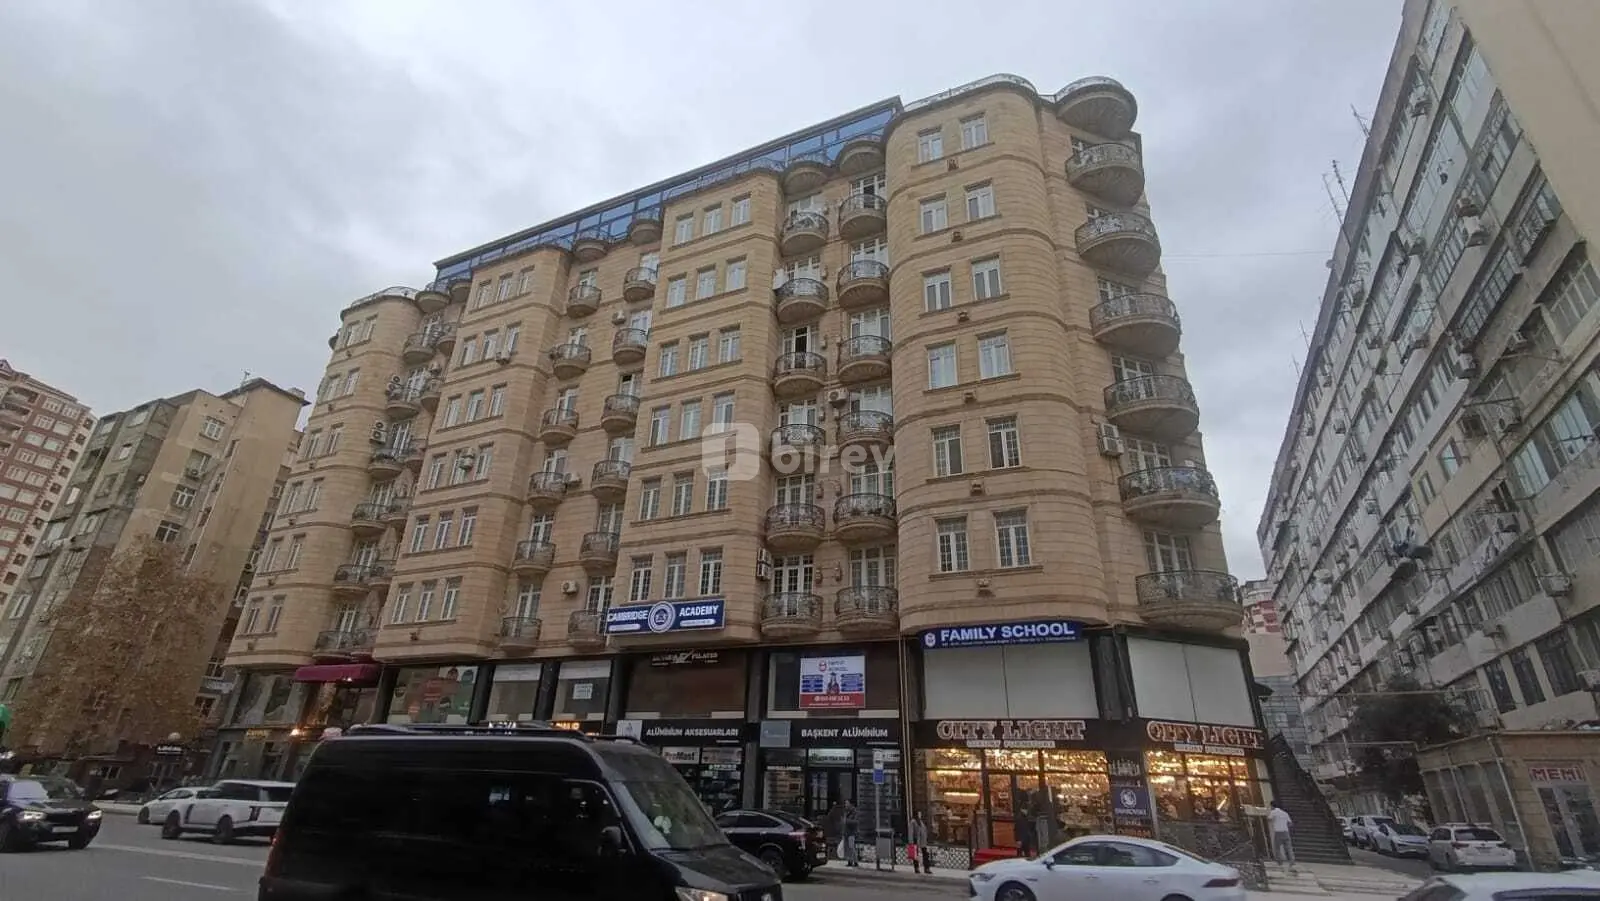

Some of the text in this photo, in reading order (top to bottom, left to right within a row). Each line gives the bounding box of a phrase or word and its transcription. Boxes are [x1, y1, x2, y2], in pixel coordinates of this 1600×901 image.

[607, 605, 719, 622] CAMBRIDGE ACADEMY
[940, 627, 997, 642] FAMILY
[1001, 622, 1075, 638] SCHOOL
[801, 728, 839, 738] BAŞKENT
[936, 720, 1086, 740] CITY LIGHT
[1147, 720, 1264, 749] CITY LIGHT
